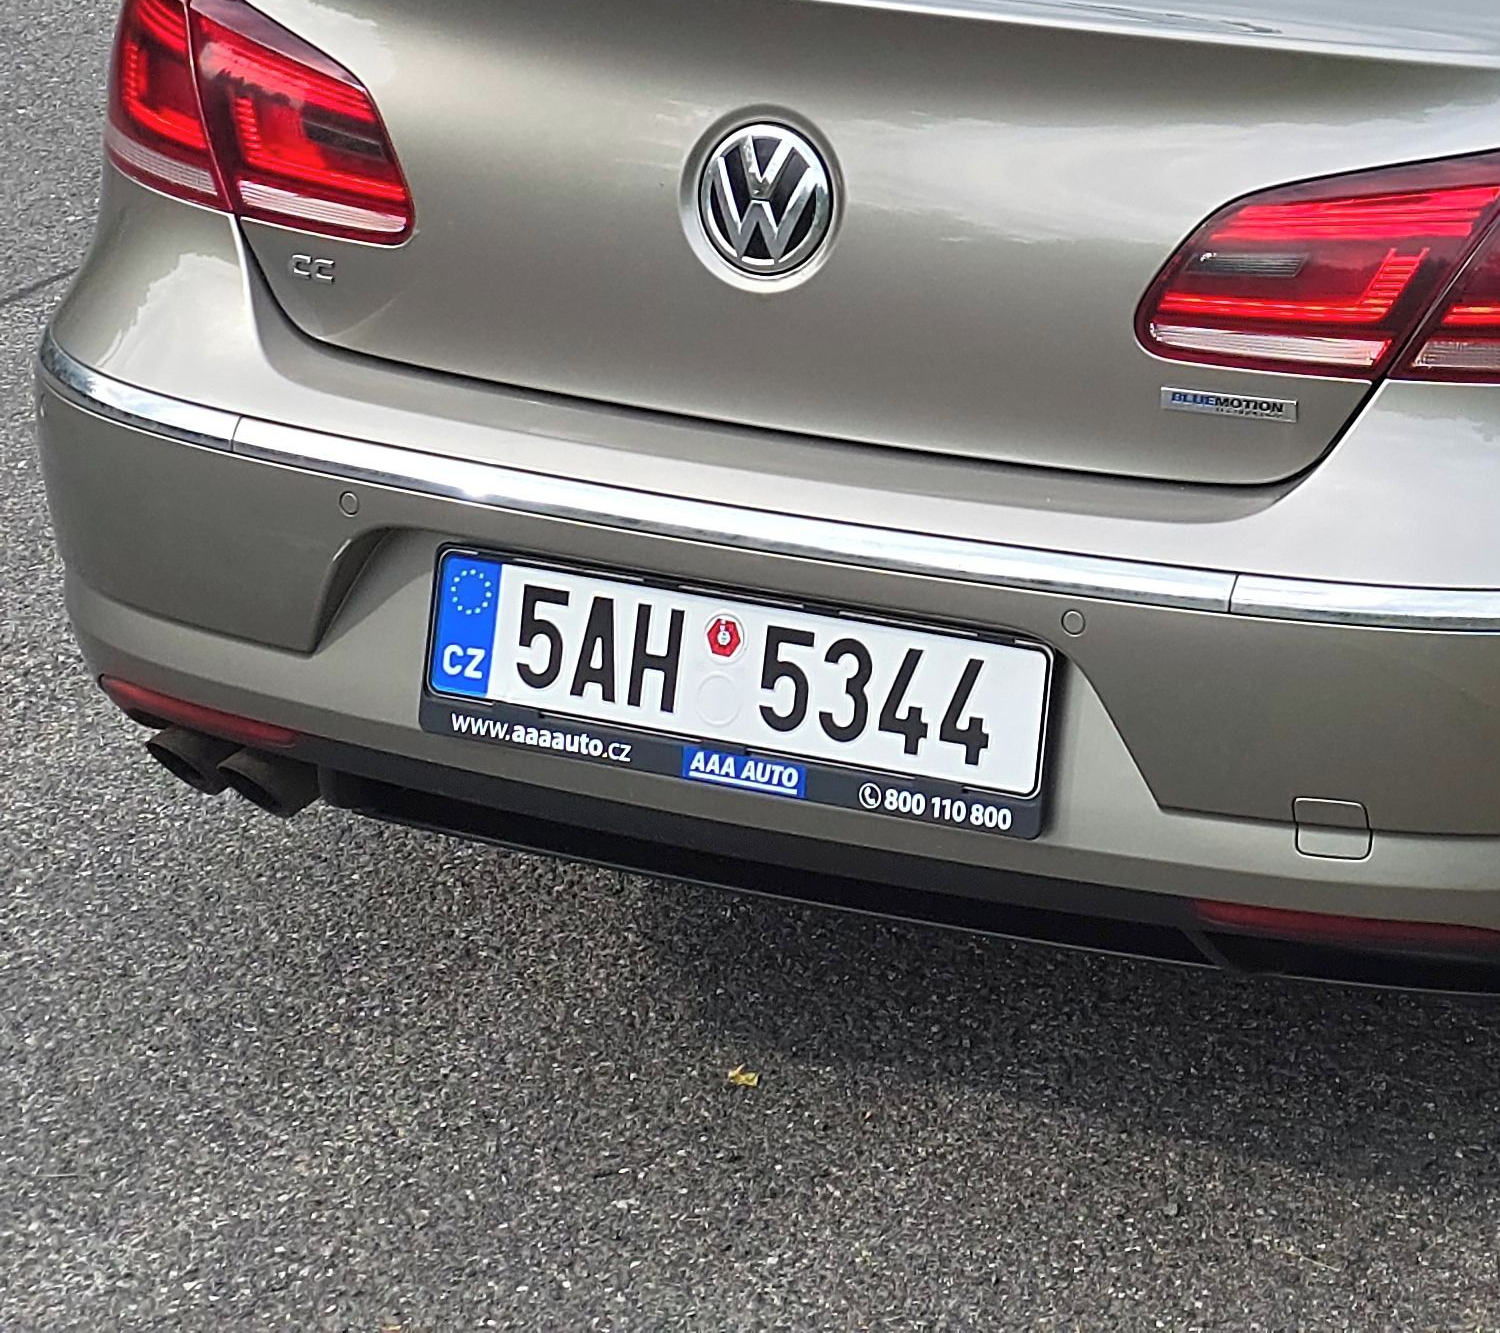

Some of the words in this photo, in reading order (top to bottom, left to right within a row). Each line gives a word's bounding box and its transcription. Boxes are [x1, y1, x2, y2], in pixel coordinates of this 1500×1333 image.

[291, 254, 335, 282] CC
[1171, 391, 1284, 413] BLUEMOTION
[442, 644, 486, 679] CZ
[516, 583, 685, 714] 5AH
[758, 625, 990, 766] 5344
[451, 712, 632, 762] www.aaaauto.cz
[690, 751, 736, 777] AAA
[740, 760, 799, 788] AUTO
[884, 788, 927, 816] 800
[931, 796, 967, 823] 110
[969, 803, 1012, 831] 800
